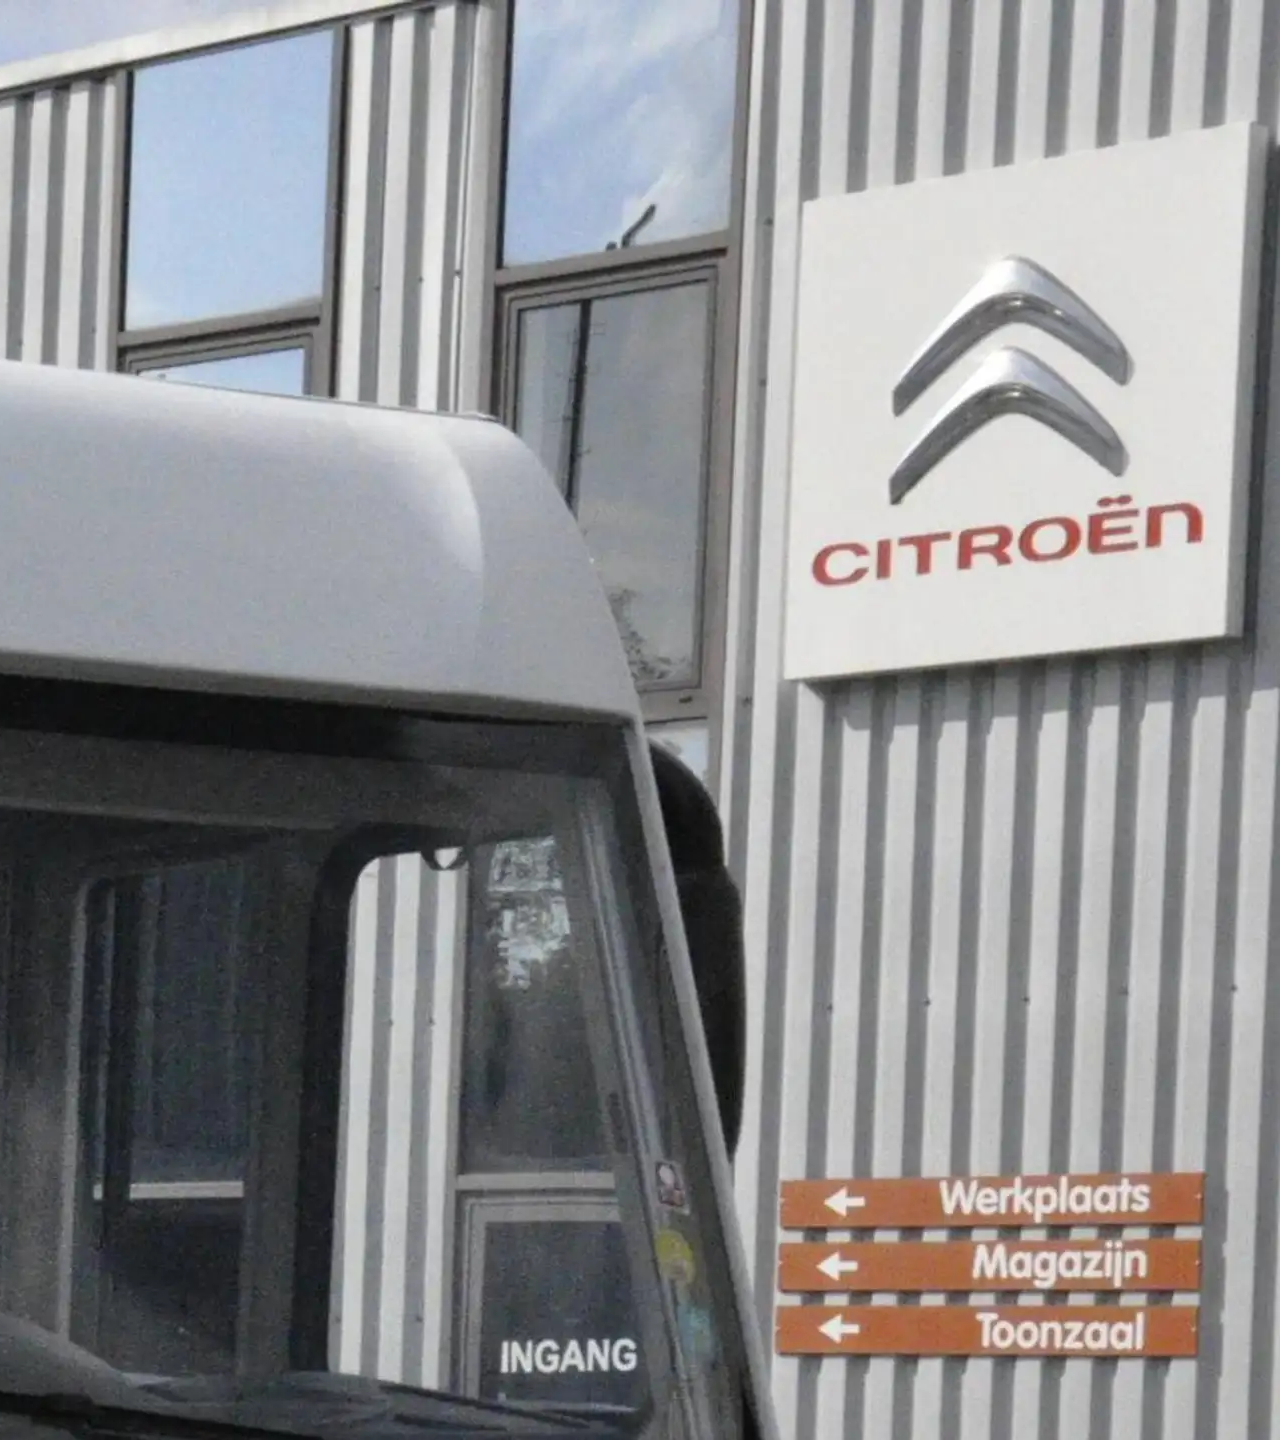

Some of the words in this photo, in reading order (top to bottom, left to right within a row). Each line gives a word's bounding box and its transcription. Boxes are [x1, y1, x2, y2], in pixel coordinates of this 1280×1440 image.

[810, 493, 1204, 588] CITROËN
[939, 1176, 1151, 1223] Werkplaats
[971, 1241, 1148, 1288] Magazijn
[975, 1311, 1144, 1350] Toonzaal
[499, 1337, 638, 1374] INGANG
